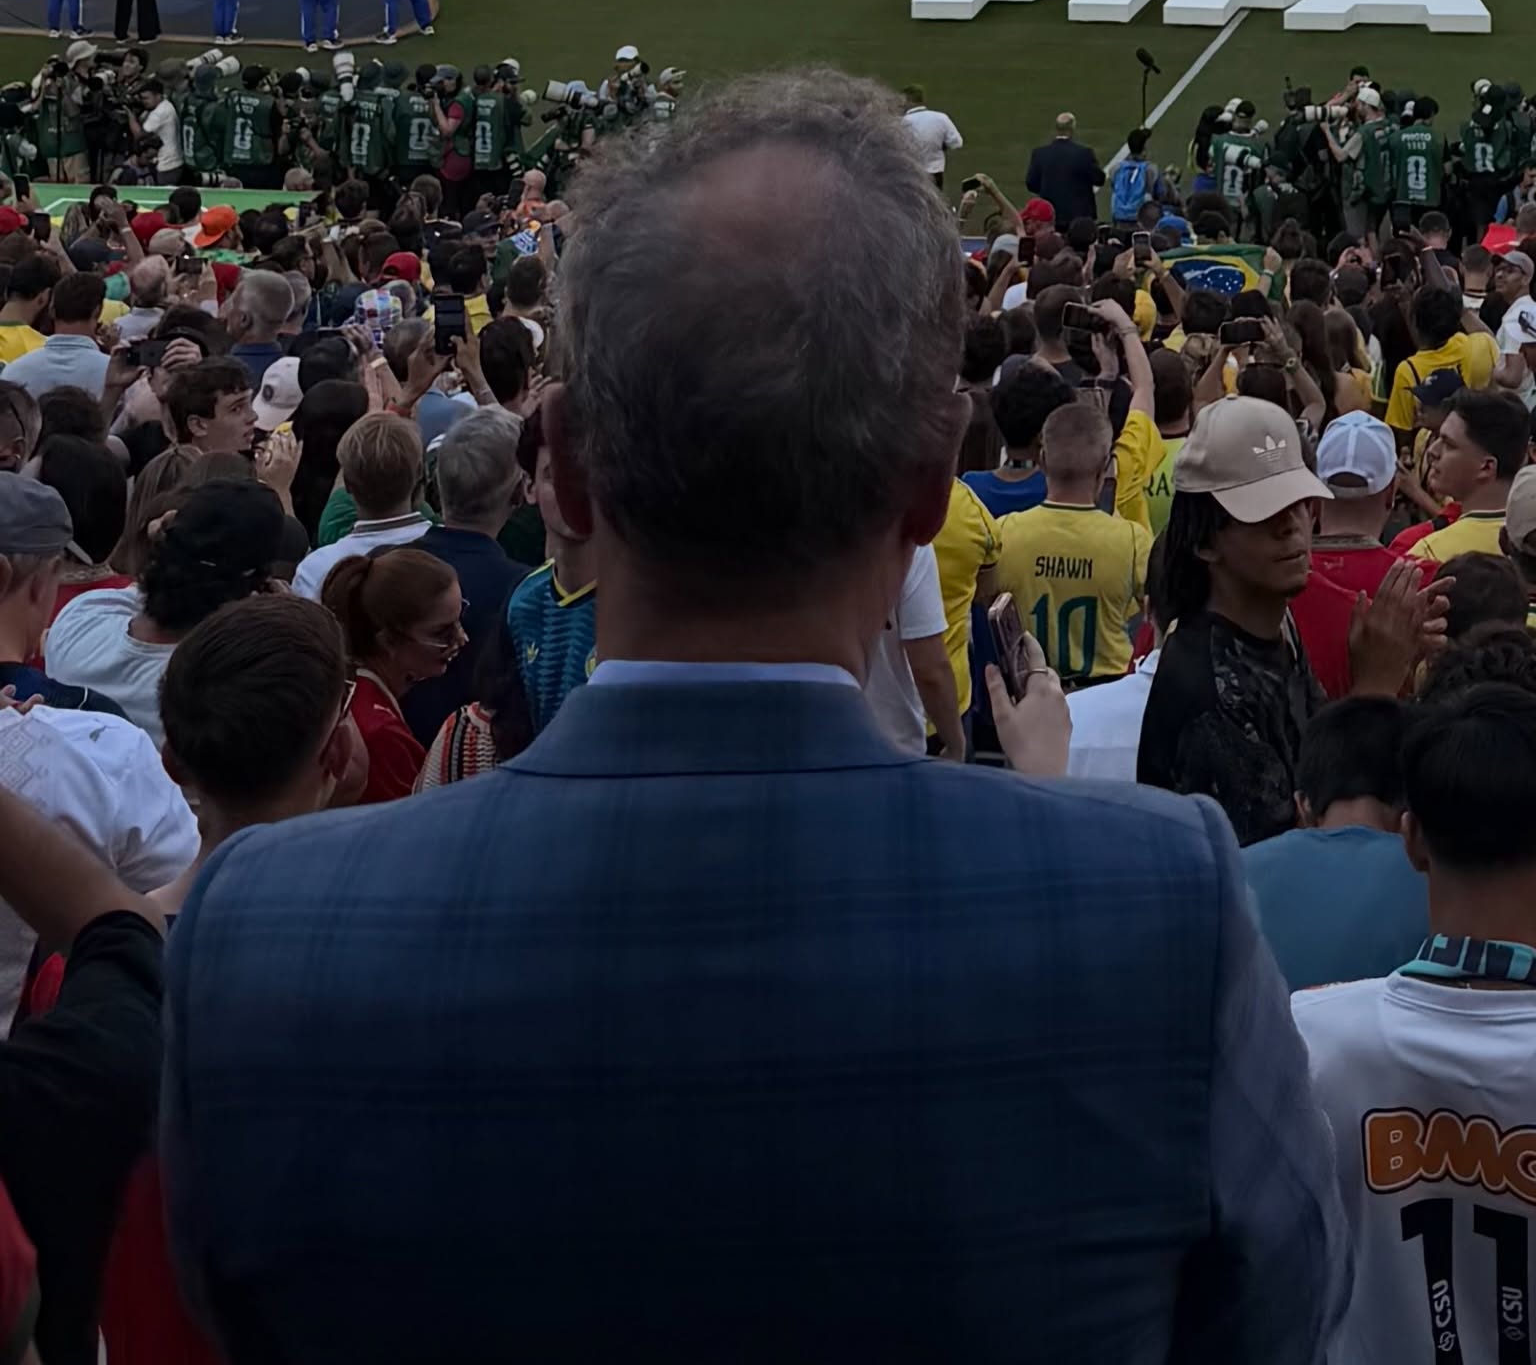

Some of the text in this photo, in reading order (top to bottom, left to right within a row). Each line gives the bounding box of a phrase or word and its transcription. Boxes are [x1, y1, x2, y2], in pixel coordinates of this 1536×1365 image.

[1034, 555, 1094, 580] SHAWN
[1031, 593, 1098, 679] 10
[1400, 1197, 1532, 1365] 11
[1431, 1278, 1452, 1329] CSU
[1501, 1285, 1524, 1325] CSU
